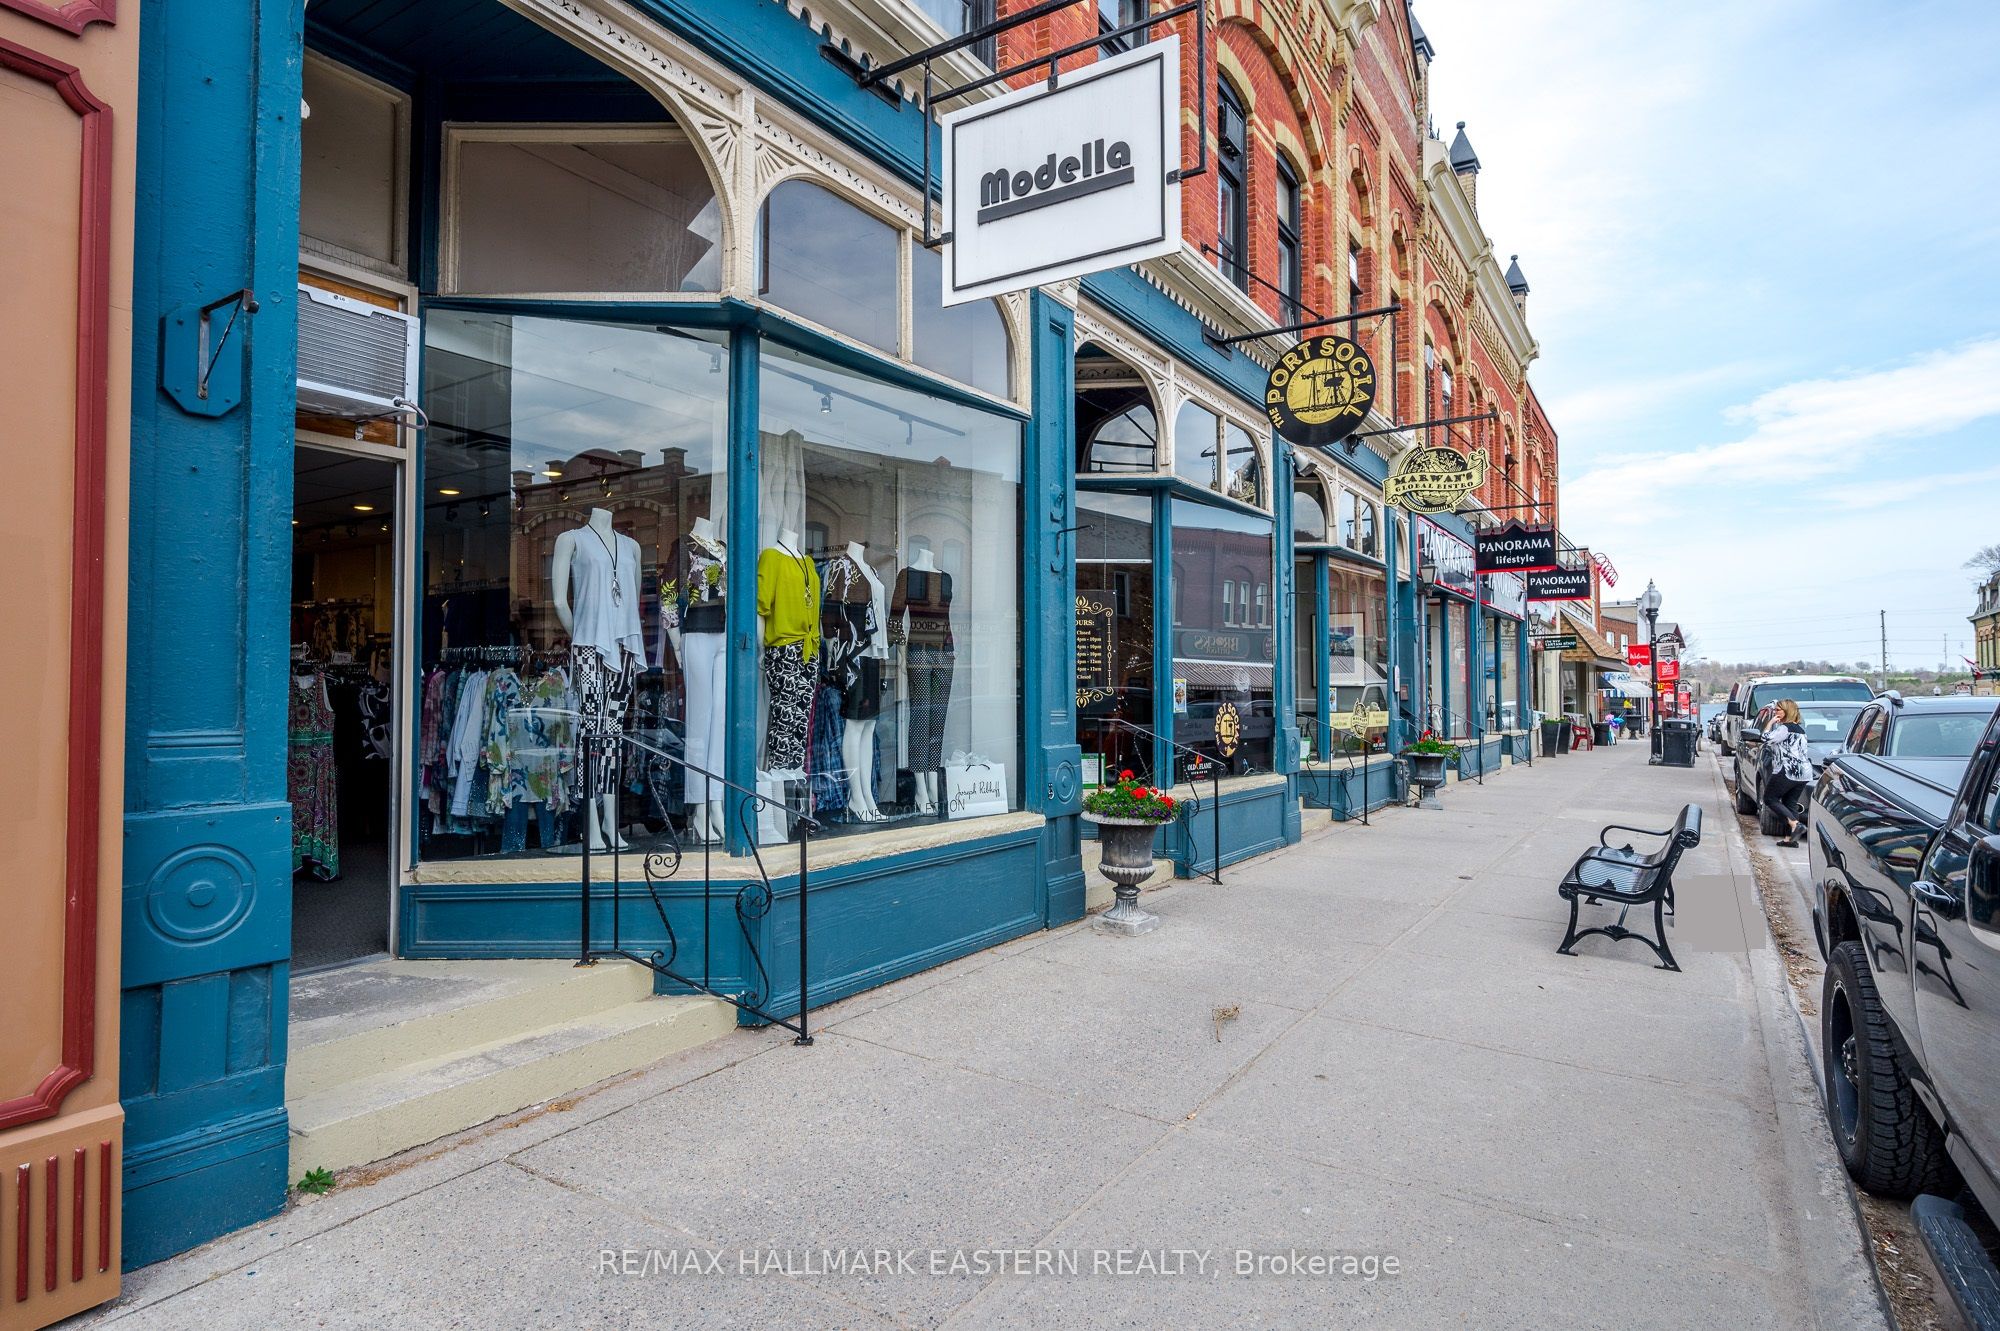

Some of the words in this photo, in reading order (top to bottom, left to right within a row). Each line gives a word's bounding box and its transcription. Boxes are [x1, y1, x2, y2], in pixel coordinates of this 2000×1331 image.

[980, 138, 1131, 208] Modella
[1267, 341, 1311, 404] PORT
[1320, 337, 1372, 417] SOCIAL
[1268, 407, 1285, 429] THE
[1394, 471, 1473, 486] MARWAN'S
[1395, 483, 1434, 493] GLOBAL
[1436, 481, 1474, 490] BISTRO
[1479, 538, 1551, 553] PANORAMA
[1495, 554, 1535, 565] lifestyle
[1530, 575, 1587, 586] PANORAMA
[1541, 587, 1576, 595] furniture
[955, 783, 977, 800] Joseph
